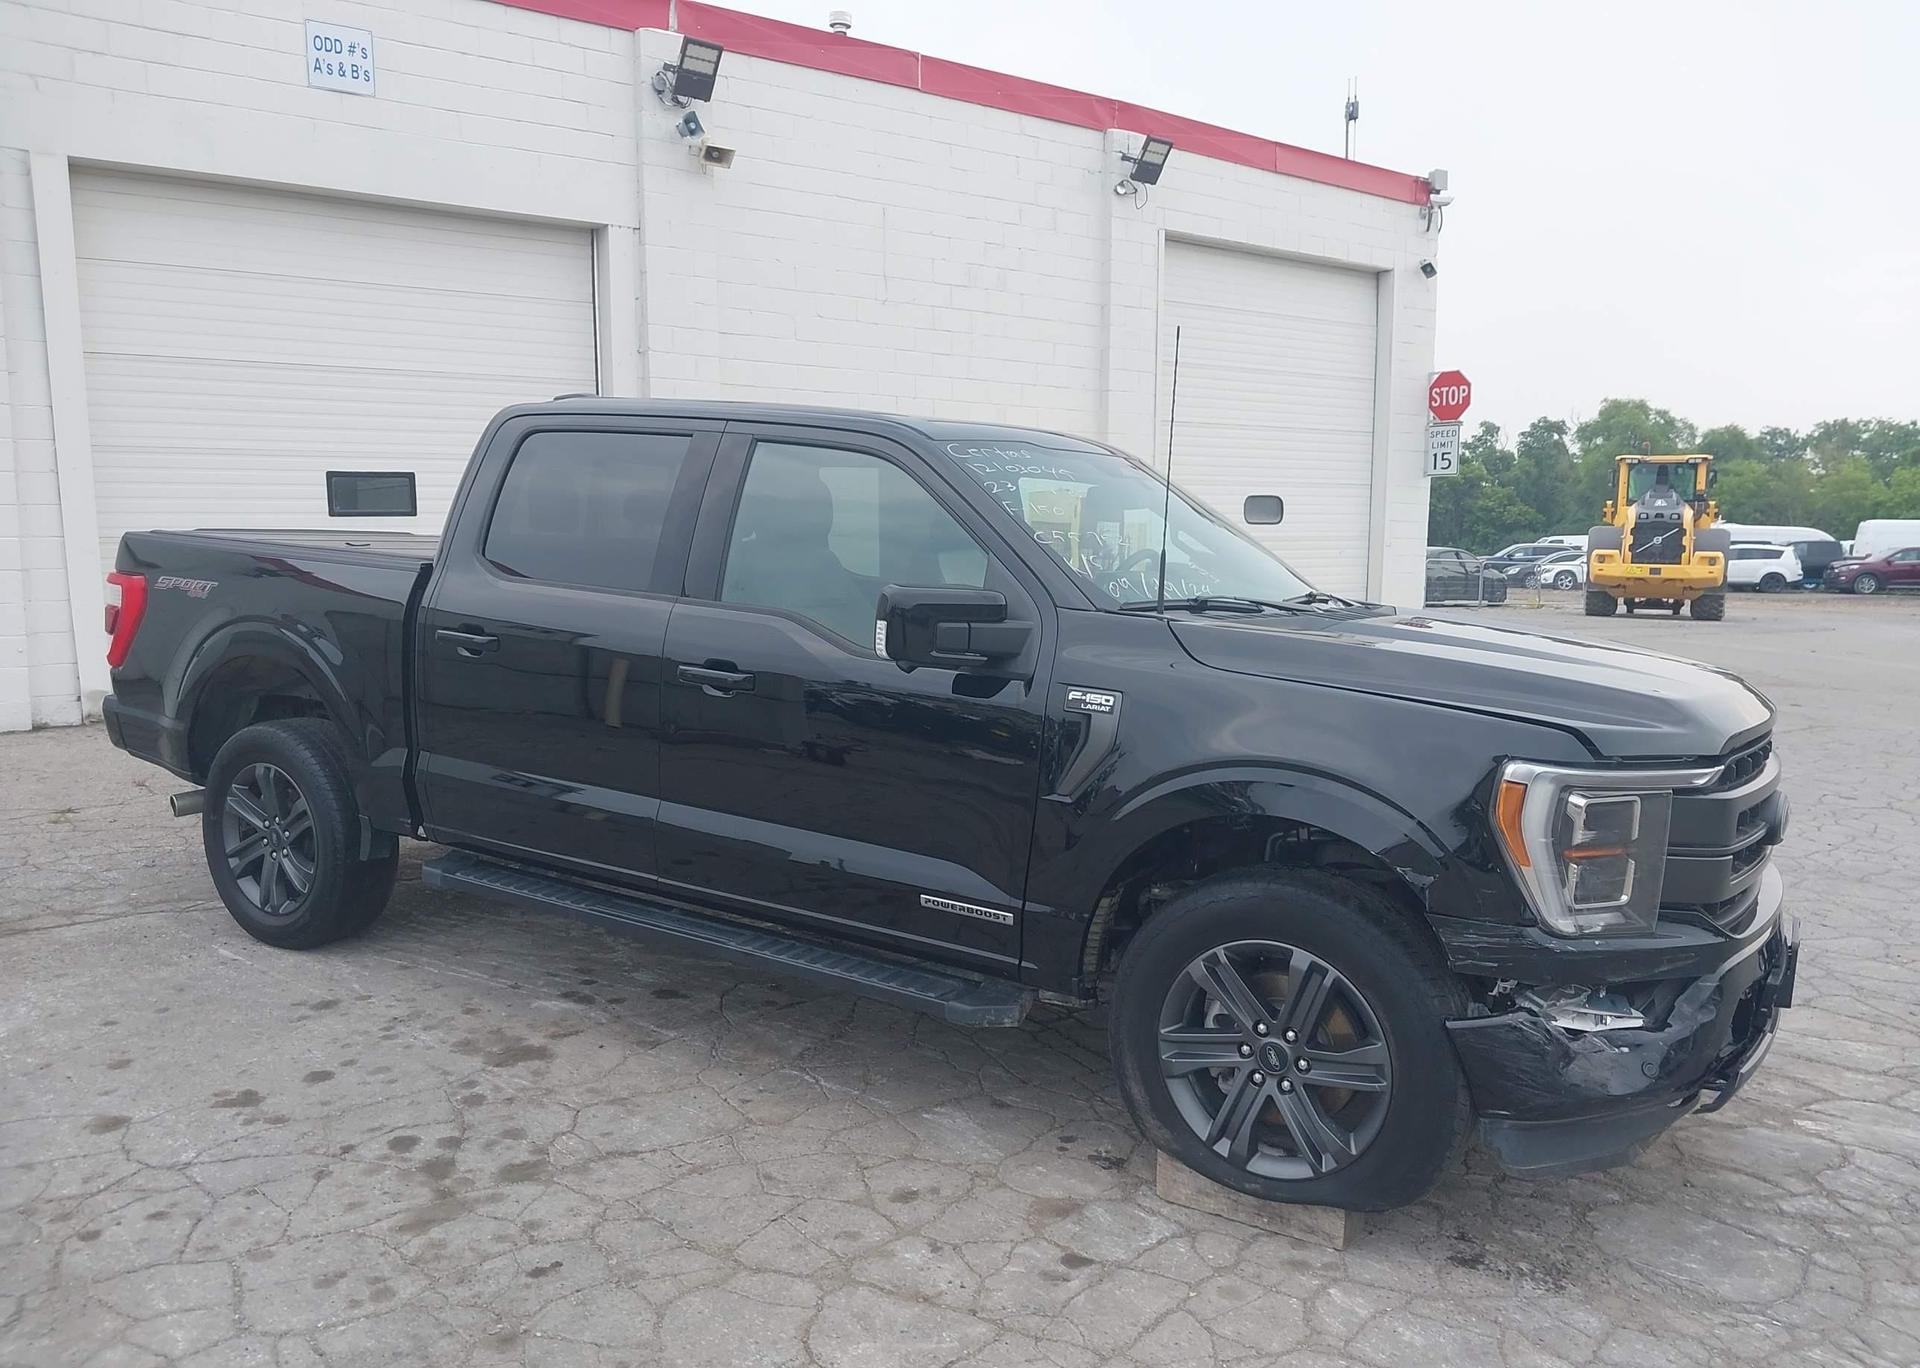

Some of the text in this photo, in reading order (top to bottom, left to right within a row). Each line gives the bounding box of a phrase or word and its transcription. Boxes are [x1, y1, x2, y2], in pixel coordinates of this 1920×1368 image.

[313, 35, 368, 60] ODD #'s
[313, 57, 370, 82] A's & B's
[1431, 385, 1469, 407] STOP
[1430, 429, 1457, 439] SPEED
[1431, 440, 1454, 450] LIMIT
[1432, 451, 1452, 471] 15
[983, 480, 1017, 494] 23
[154, 575, 219, 593] SPORT
[1068, 690, 1115, 706] F-150
[1080, 702, 1112, 713] LARIAT
[923, 897, 1009, 922] POWERBOOST
